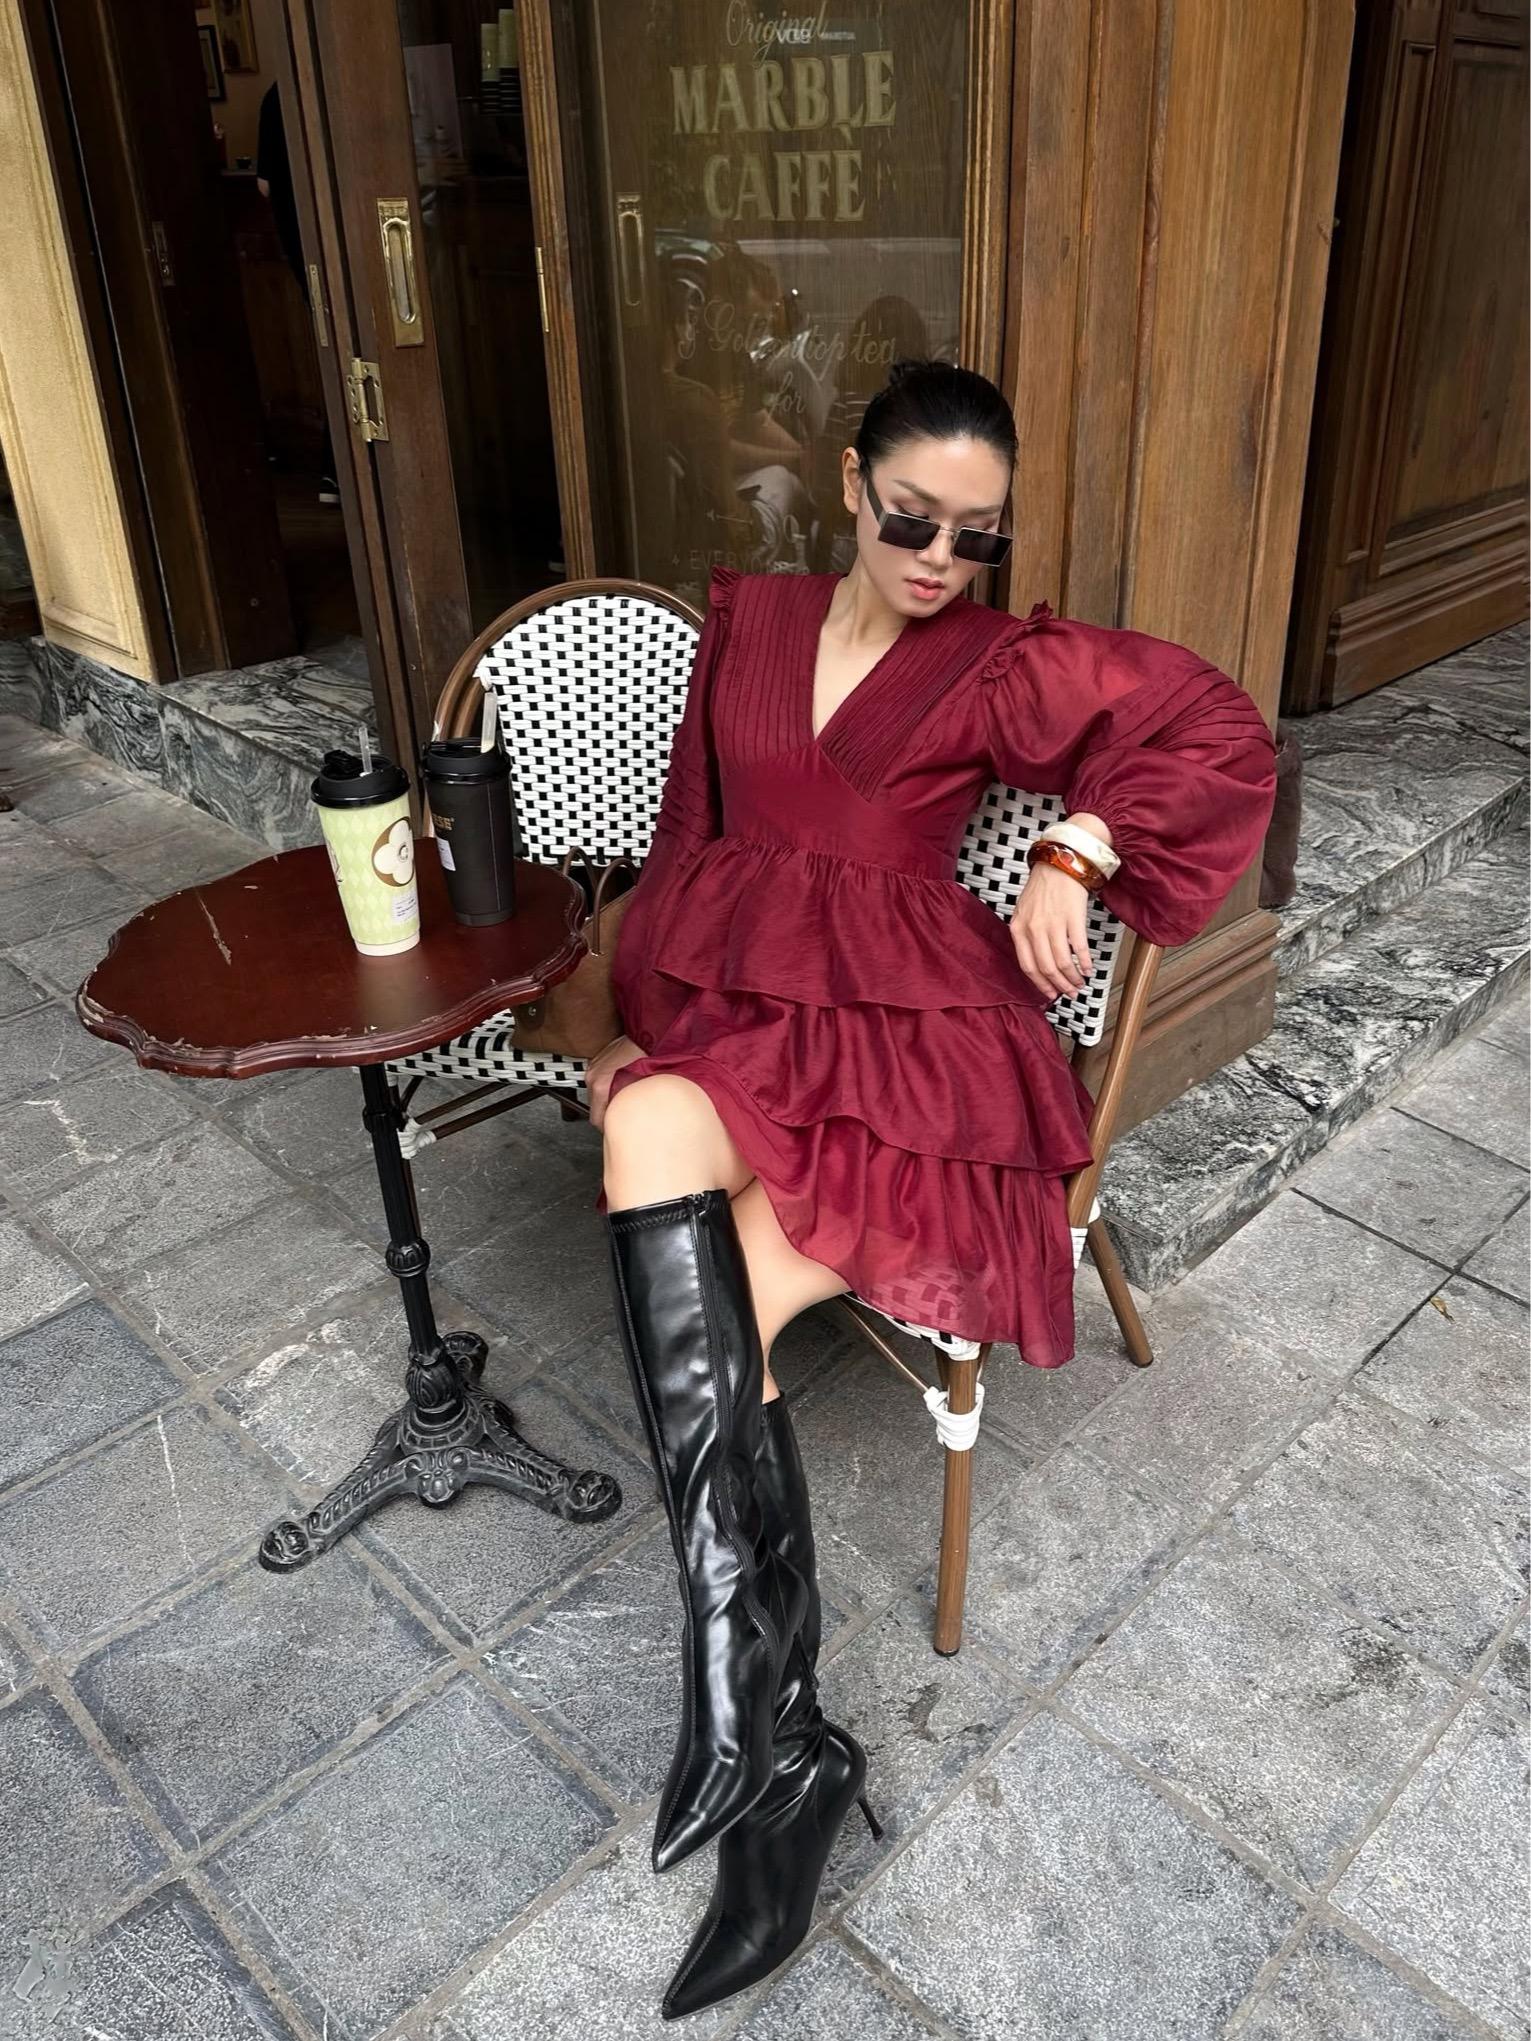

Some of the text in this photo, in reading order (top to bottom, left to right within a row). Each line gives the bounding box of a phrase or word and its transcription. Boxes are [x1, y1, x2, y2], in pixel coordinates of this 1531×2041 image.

[726, 0, 829, 69] Original
[670, 51, 896, 135] MARBLE
[766, 371, 807, 417] for
